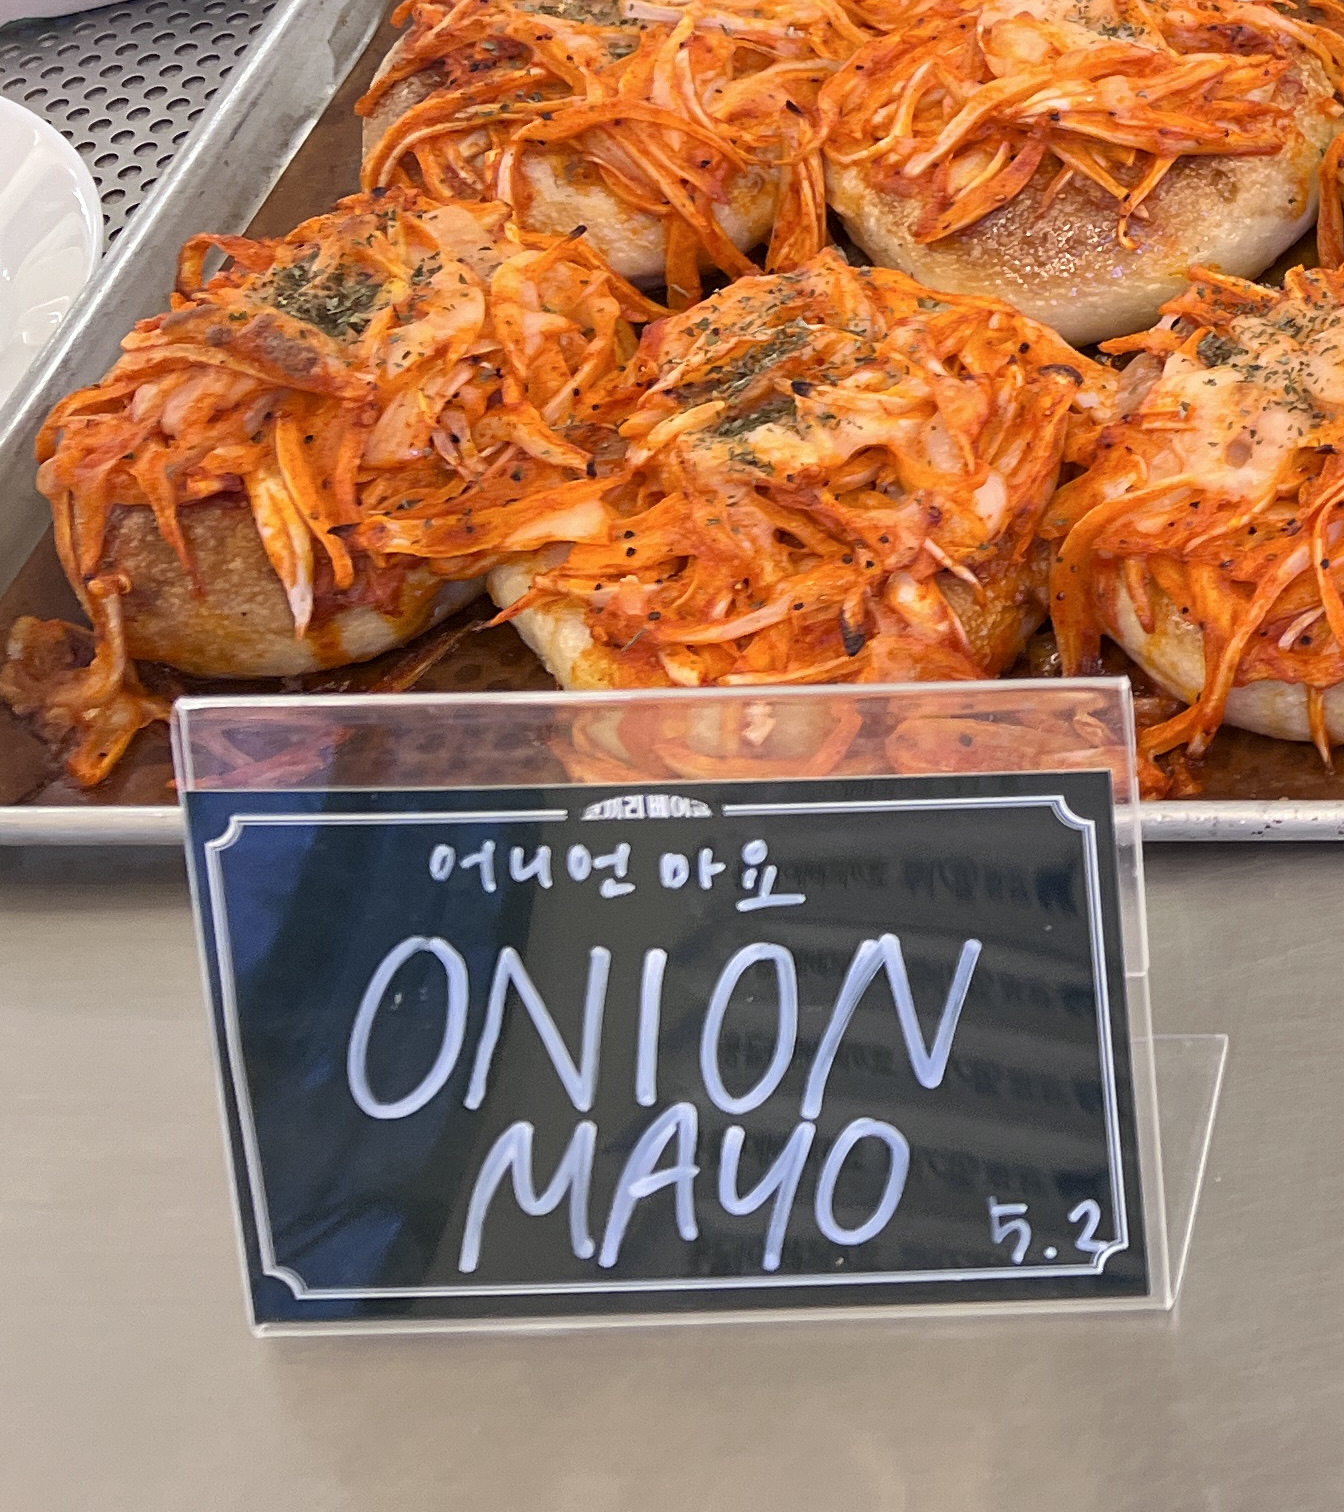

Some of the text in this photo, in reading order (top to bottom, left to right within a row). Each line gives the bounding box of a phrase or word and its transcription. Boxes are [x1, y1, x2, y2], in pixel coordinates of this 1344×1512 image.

[659, 839, 807, 912] 마요
[347, 934, 983, 1120] ONION
[458, 1101, 912, 1273] MAYO
[988, 1196, 1104, 1264] 5.2
